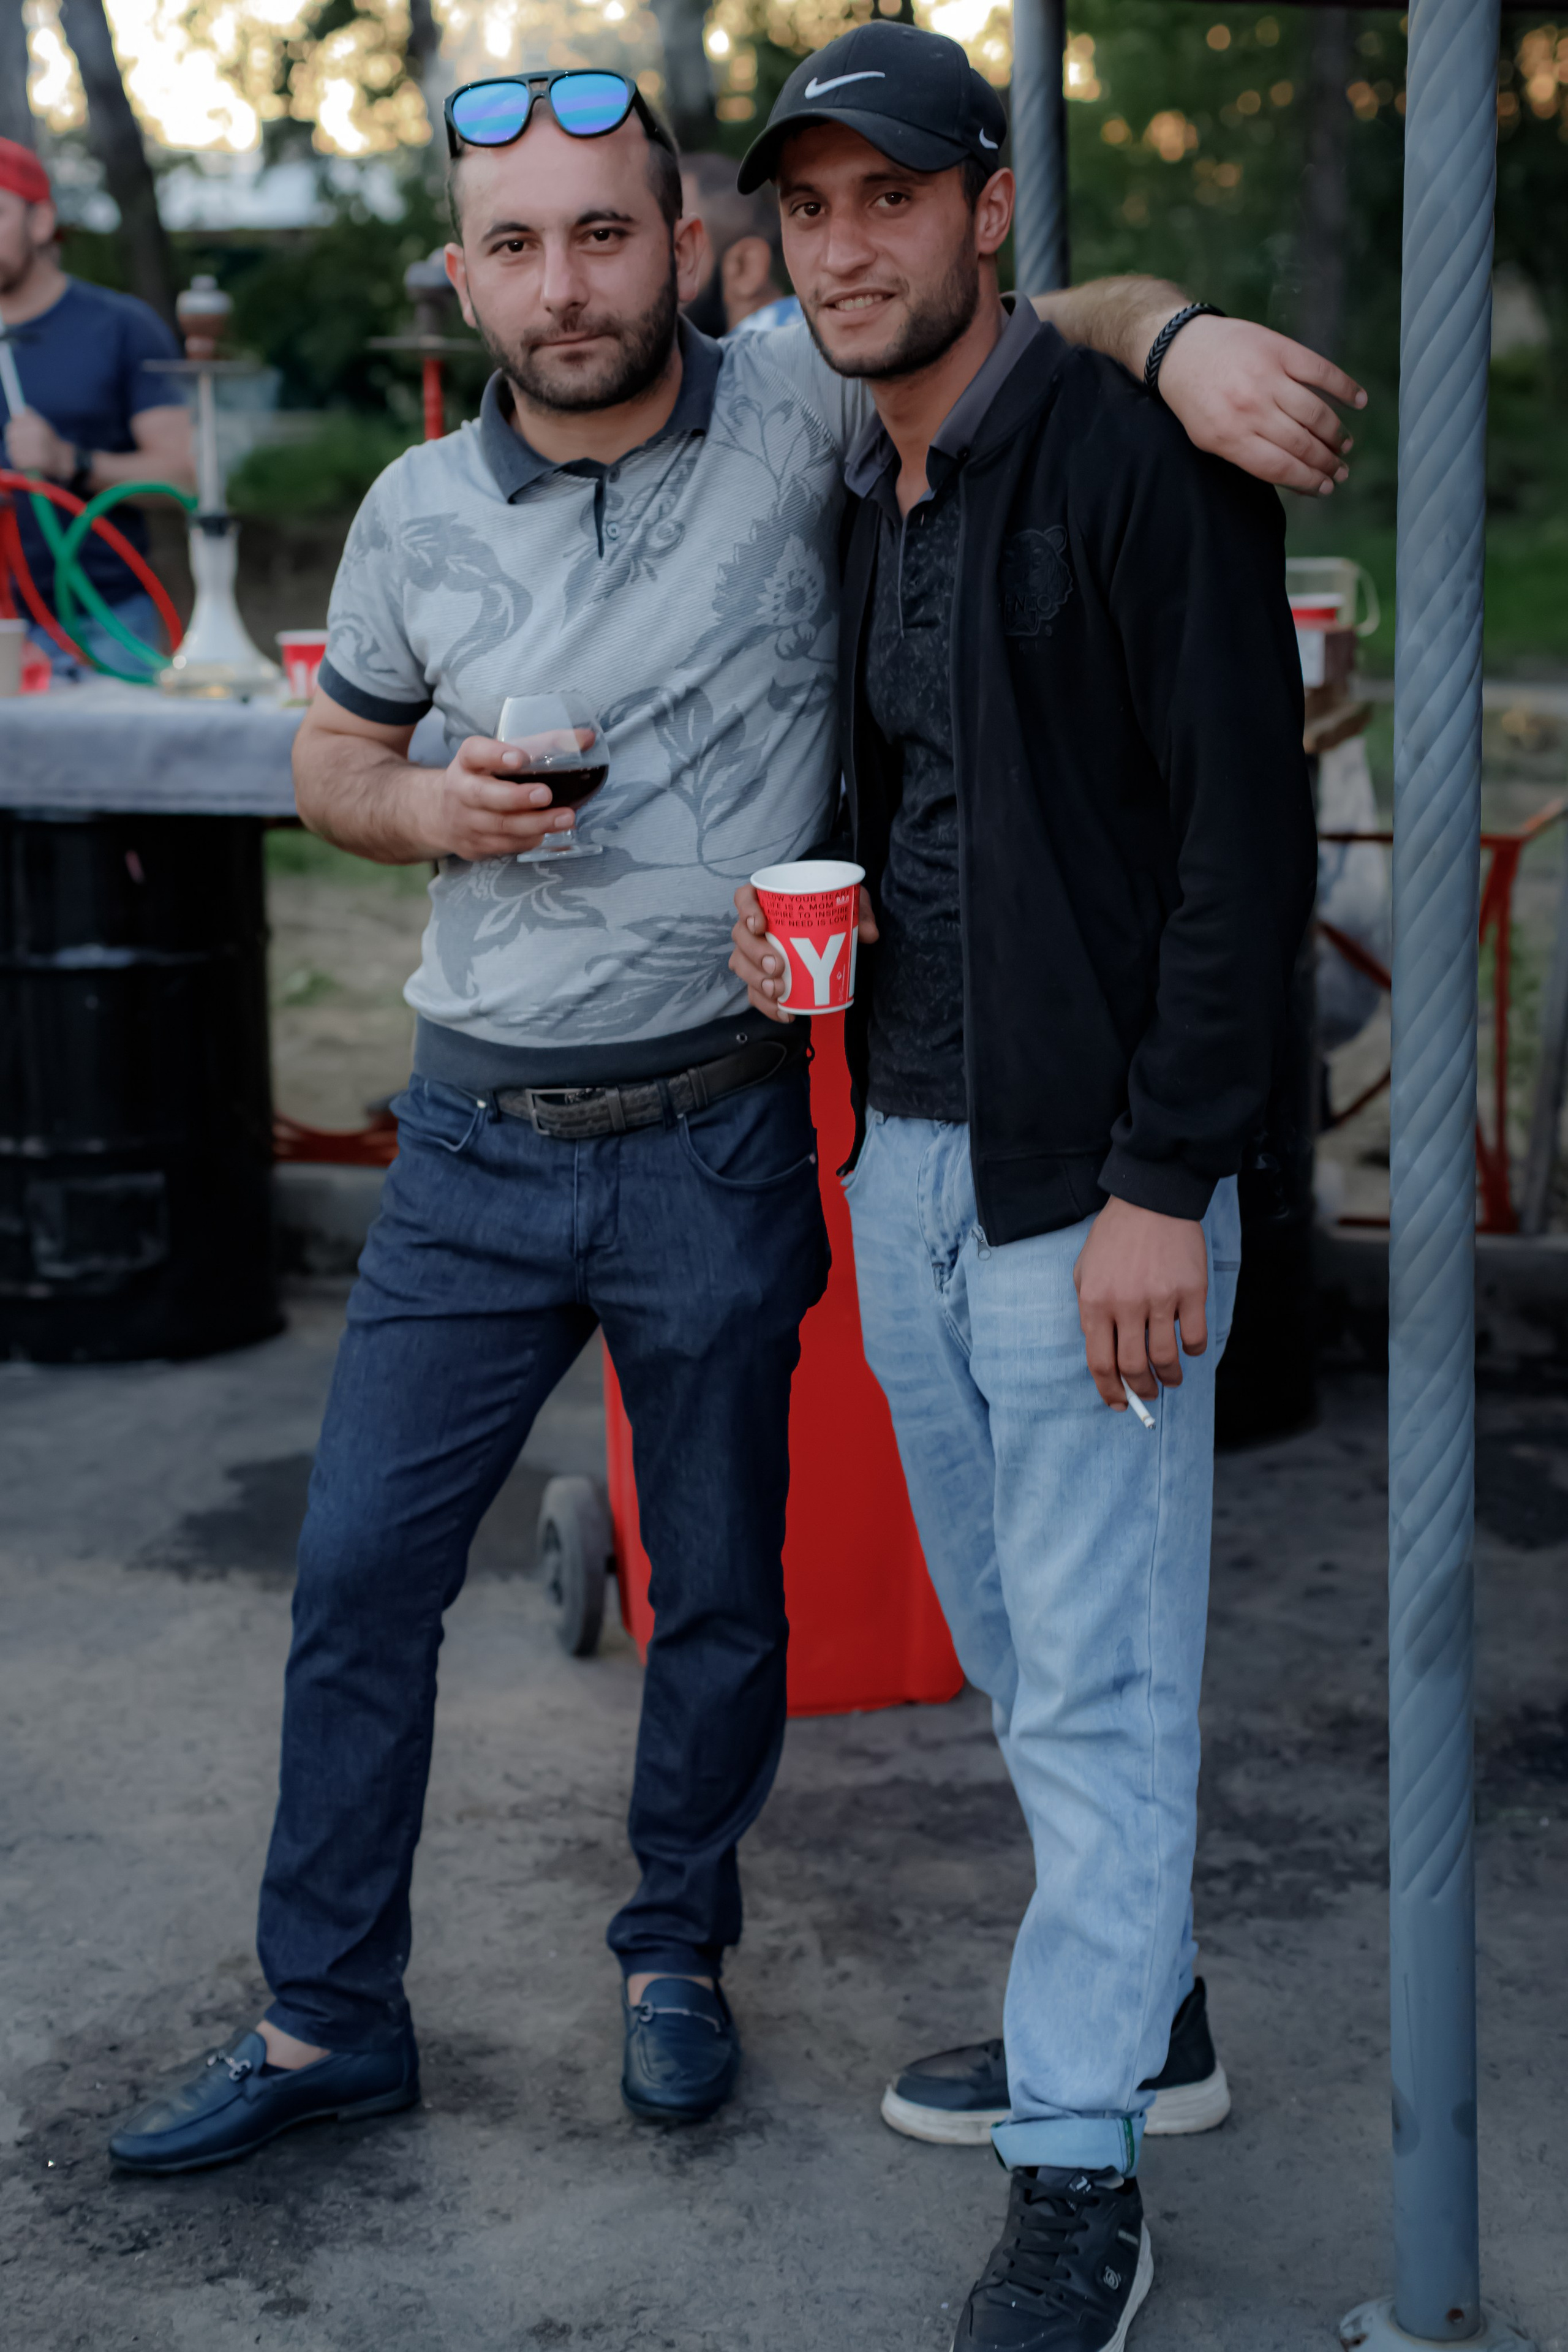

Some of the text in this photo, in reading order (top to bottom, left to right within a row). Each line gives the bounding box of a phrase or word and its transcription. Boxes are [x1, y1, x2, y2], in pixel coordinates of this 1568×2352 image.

[821, 889, 850, 901] HEART
[809, 901, 834, 910] MOM
[815, 905, 848, 918] INSPIRE
[829, 914, 848, 925] LOVE
